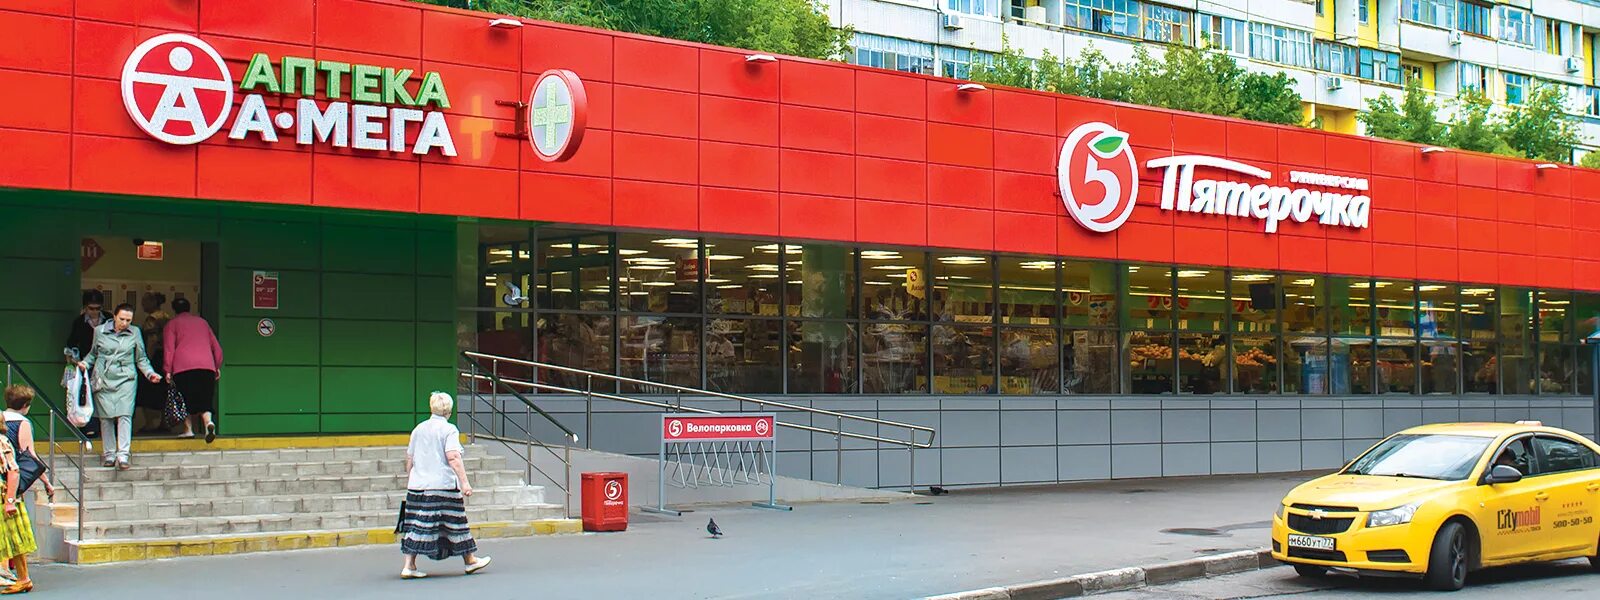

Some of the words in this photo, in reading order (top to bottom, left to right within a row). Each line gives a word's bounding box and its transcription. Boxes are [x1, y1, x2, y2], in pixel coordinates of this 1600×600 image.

[239, 53, 451, 108] АПТЕКА
[1080, 153, 1121, 220] 5
[1146, 155, 1370, 233] Пятерочка
[686, 422, 752, 435] Велопарковка
[1553, 516, 1593, 529] 500-50-50
